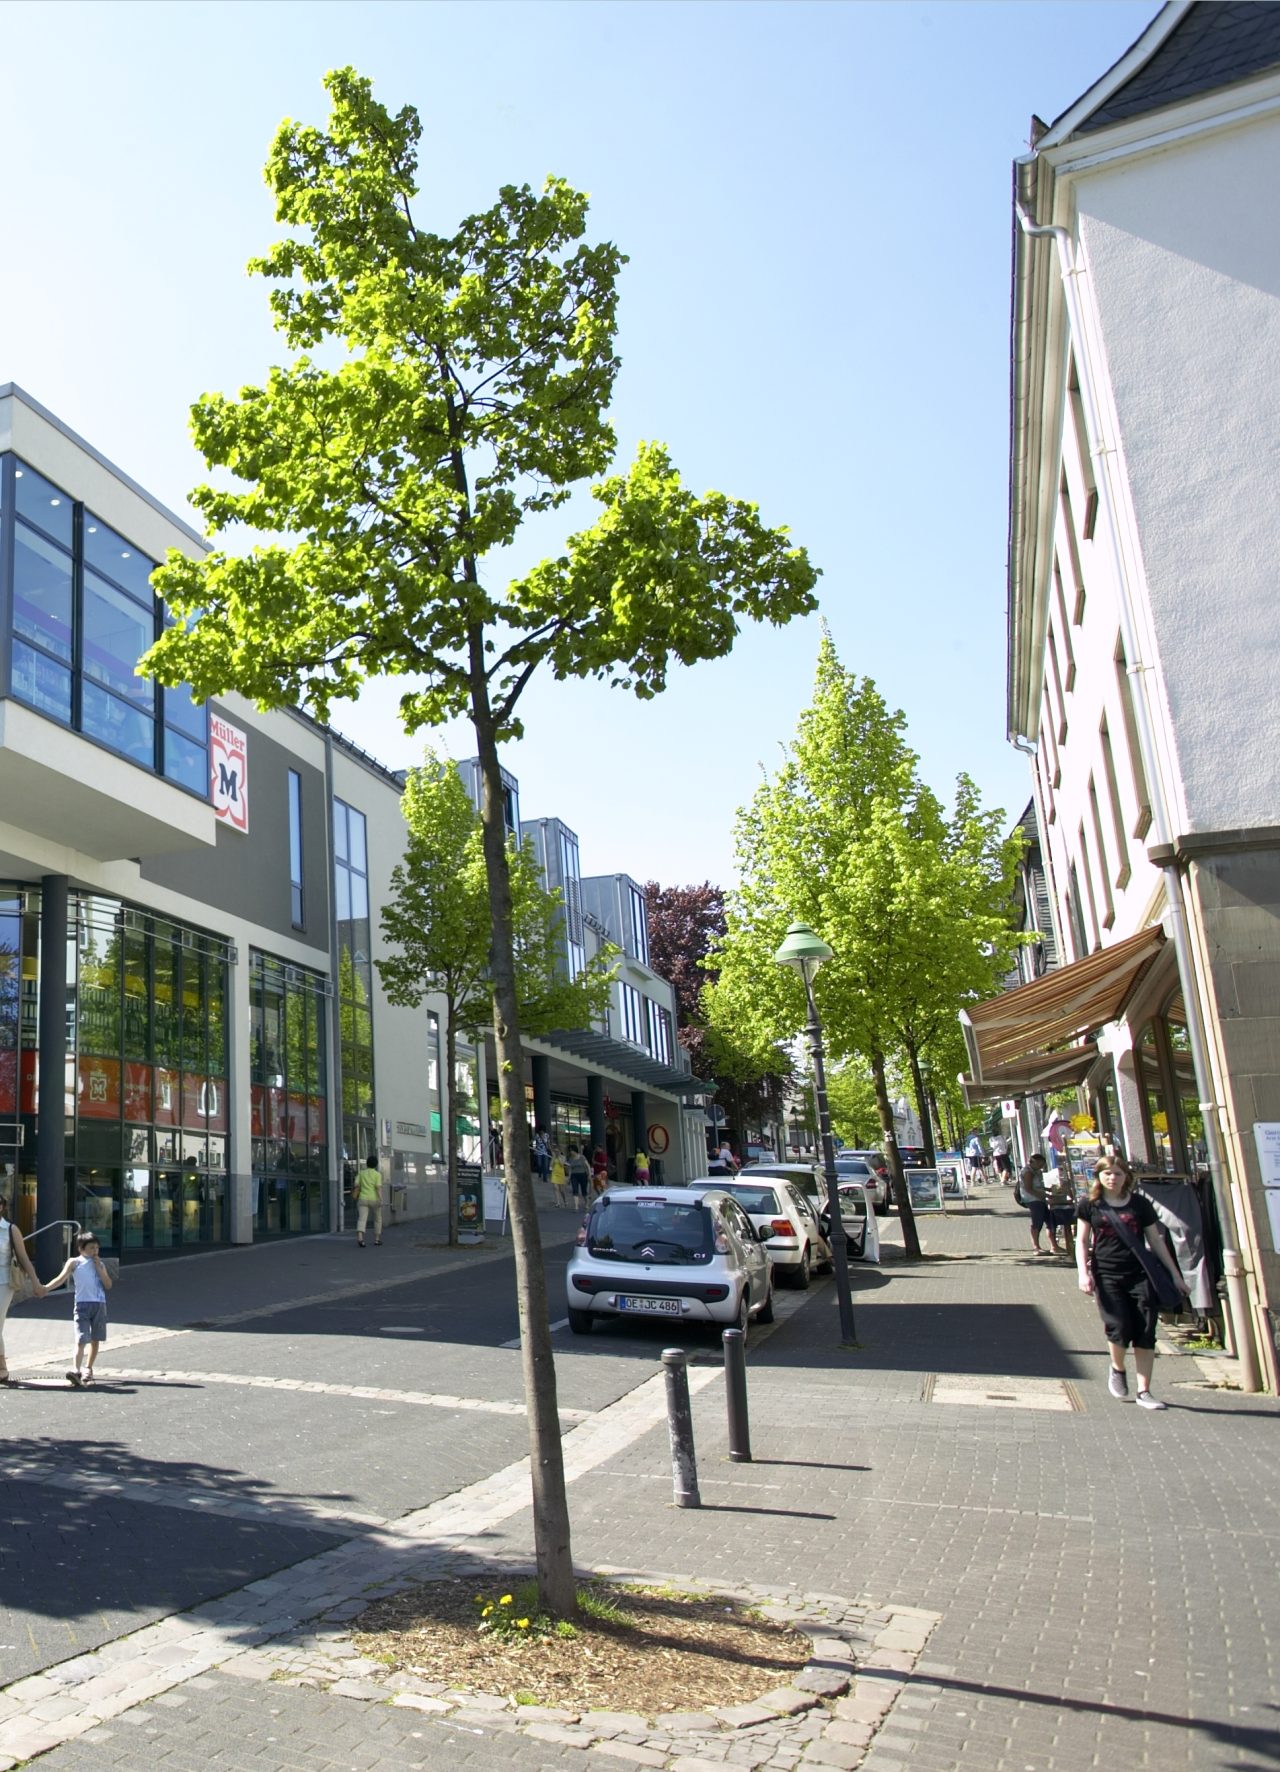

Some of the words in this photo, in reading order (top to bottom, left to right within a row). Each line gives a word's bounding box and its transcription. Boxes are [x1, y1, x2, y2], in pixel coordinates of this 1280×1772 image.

[210, 718, 245, 751] Müller
[219, 762, 238, 802] M
[644, 1300, 657, 1310] JC
[659, 1301, 677, 1311] 486
